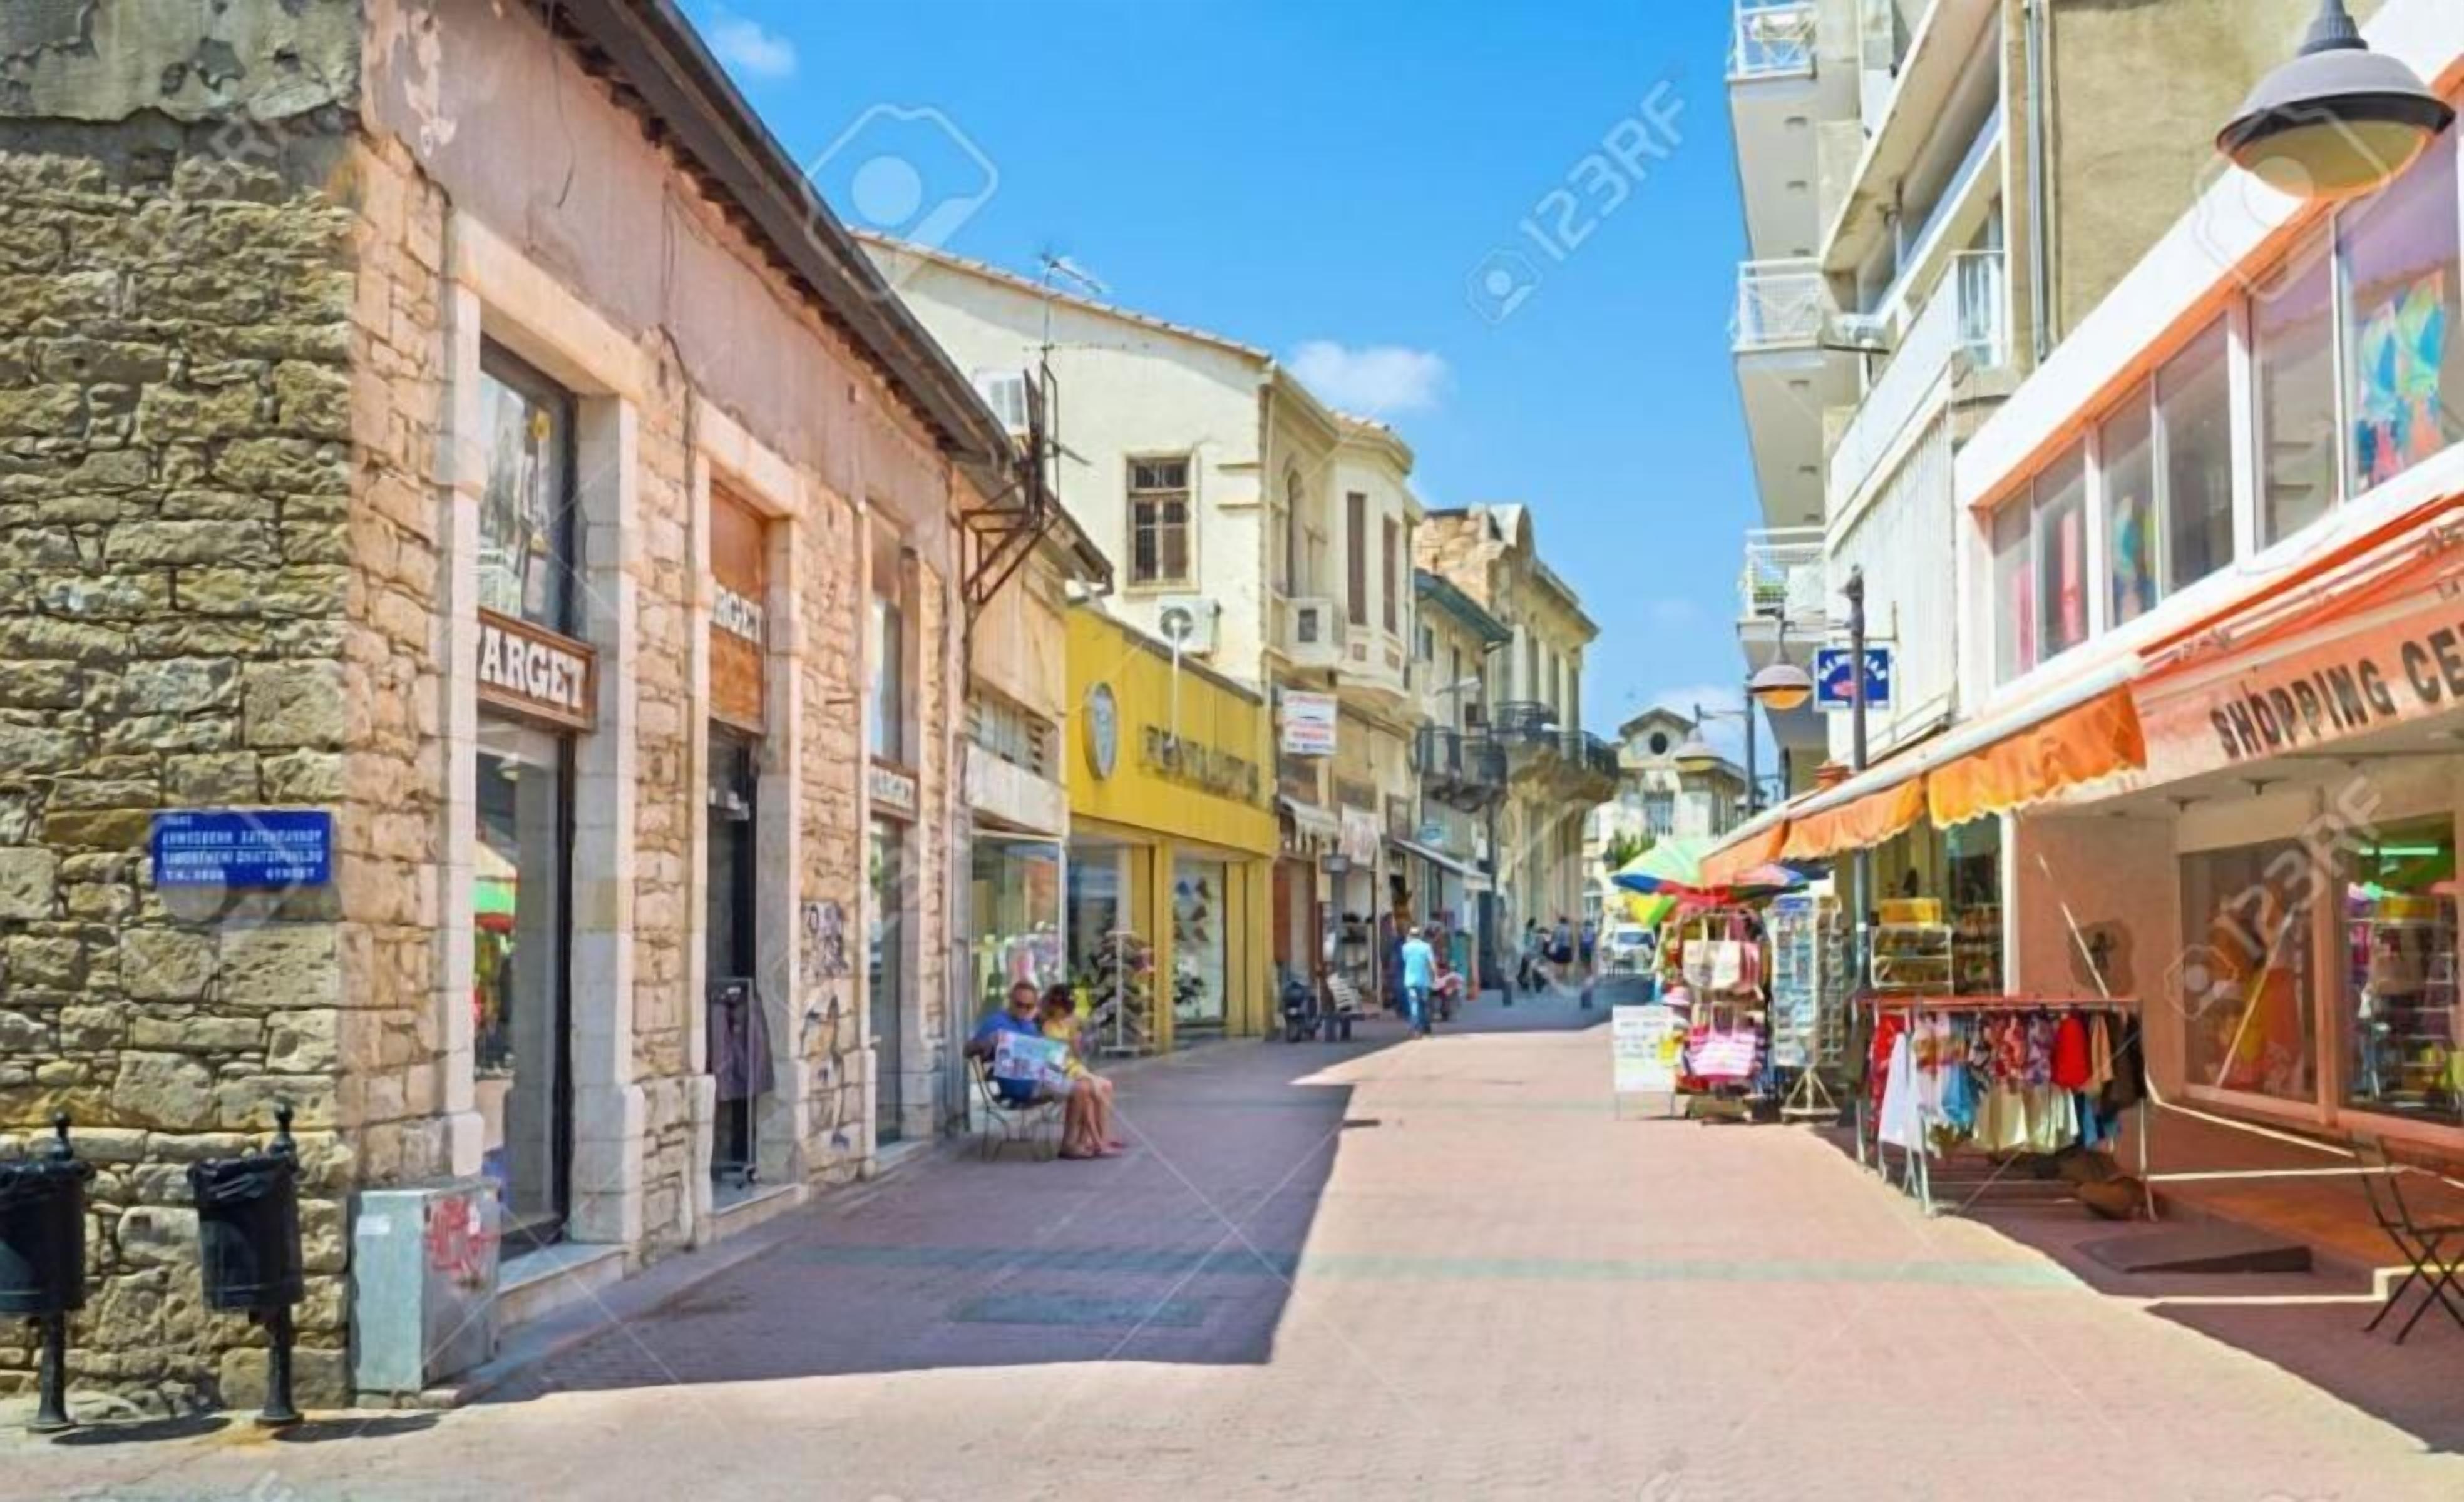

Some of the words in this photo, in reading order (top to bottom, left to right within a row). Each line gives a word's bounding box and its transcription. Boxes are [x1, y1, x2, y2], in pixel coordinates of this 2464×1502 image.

[714, 581, 763, 643] RGET
[481, 625, 586, 708] ARGET
[2209, 657, 2397, 759] SHOPPING
[2401, 621, 2464, 703] CE
